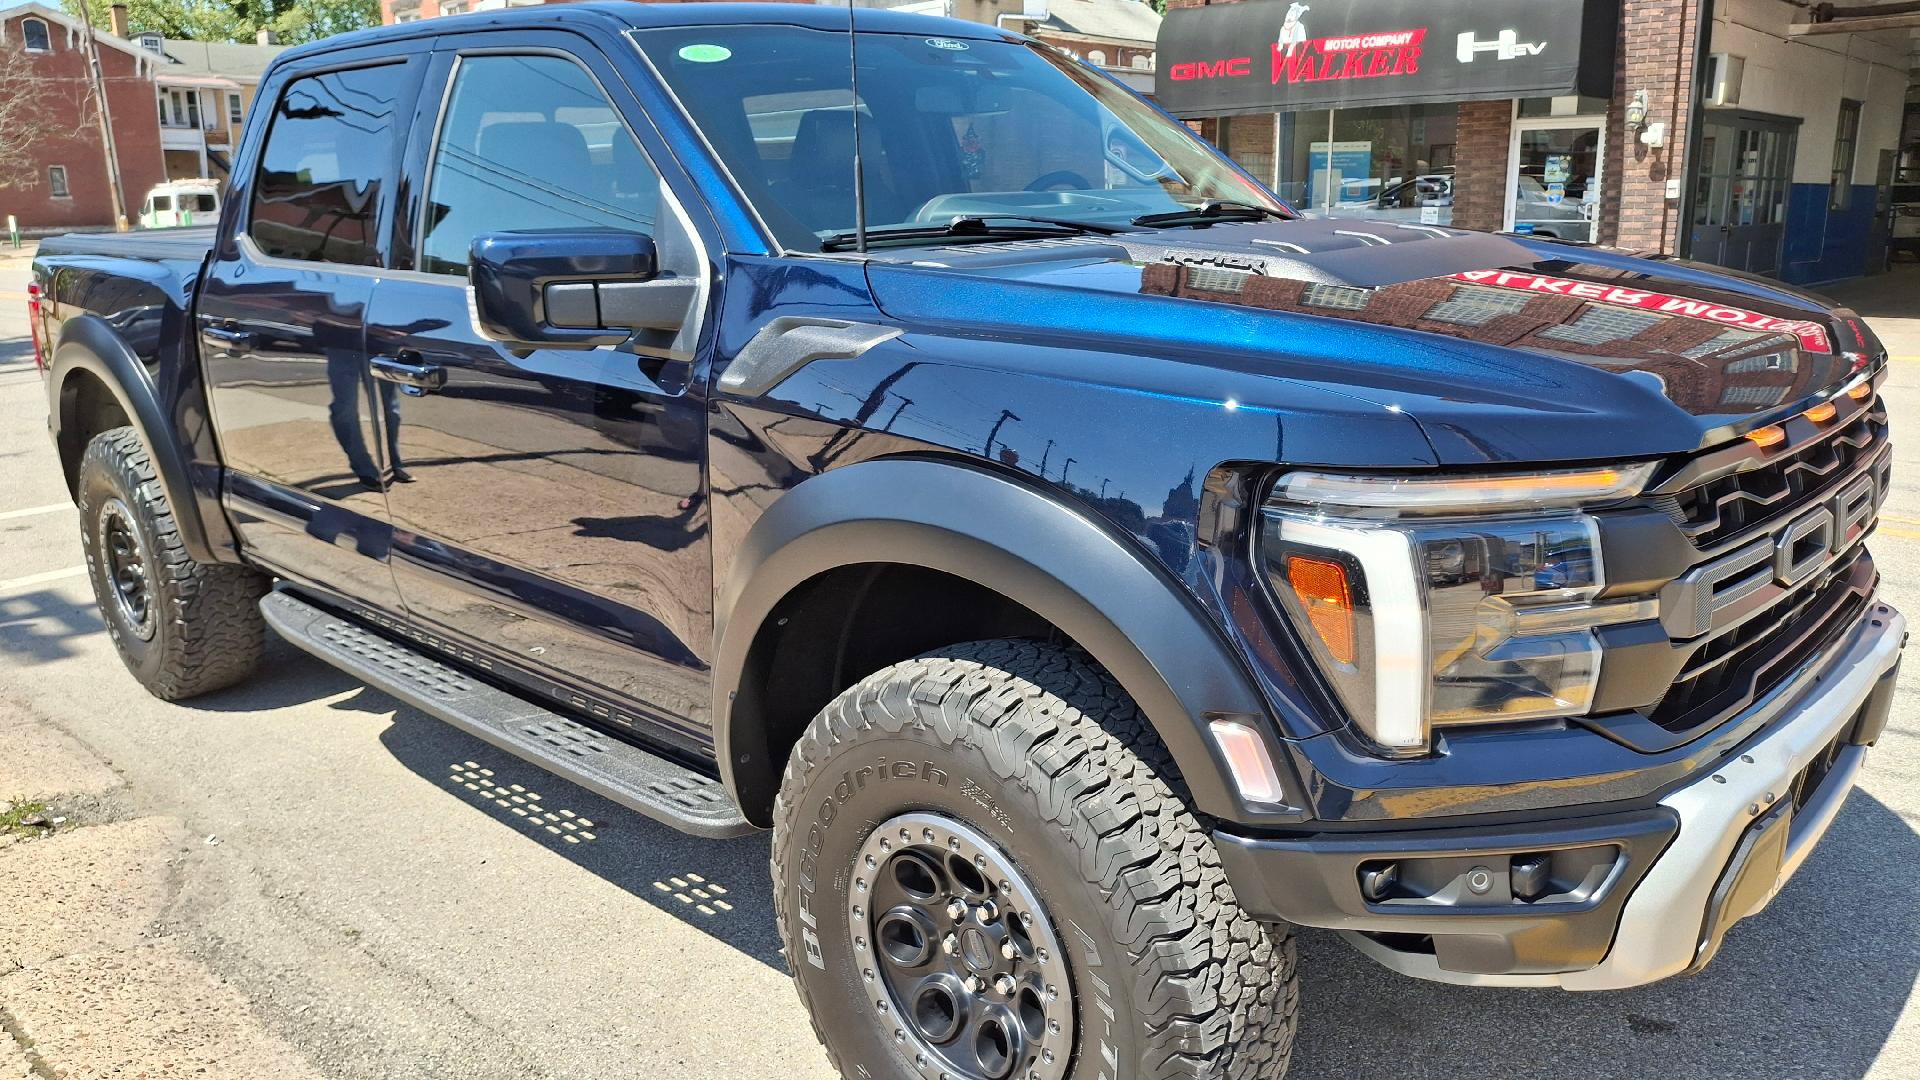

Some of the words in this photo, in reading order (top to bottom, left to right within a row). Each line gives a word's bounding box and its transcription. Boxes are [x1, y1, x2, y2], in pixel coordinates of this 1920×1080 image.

[1271, 39, 1422, 85] WALKER
[1324, 38, 1360, 51] MOTOR
[1361, 32, 1414, 48] COMPANY
[1170, 57, 1251, 81] GMC
[1685, 442, 1893, 635] FORD
[797, 756, 949, 971] BFGoodrich
